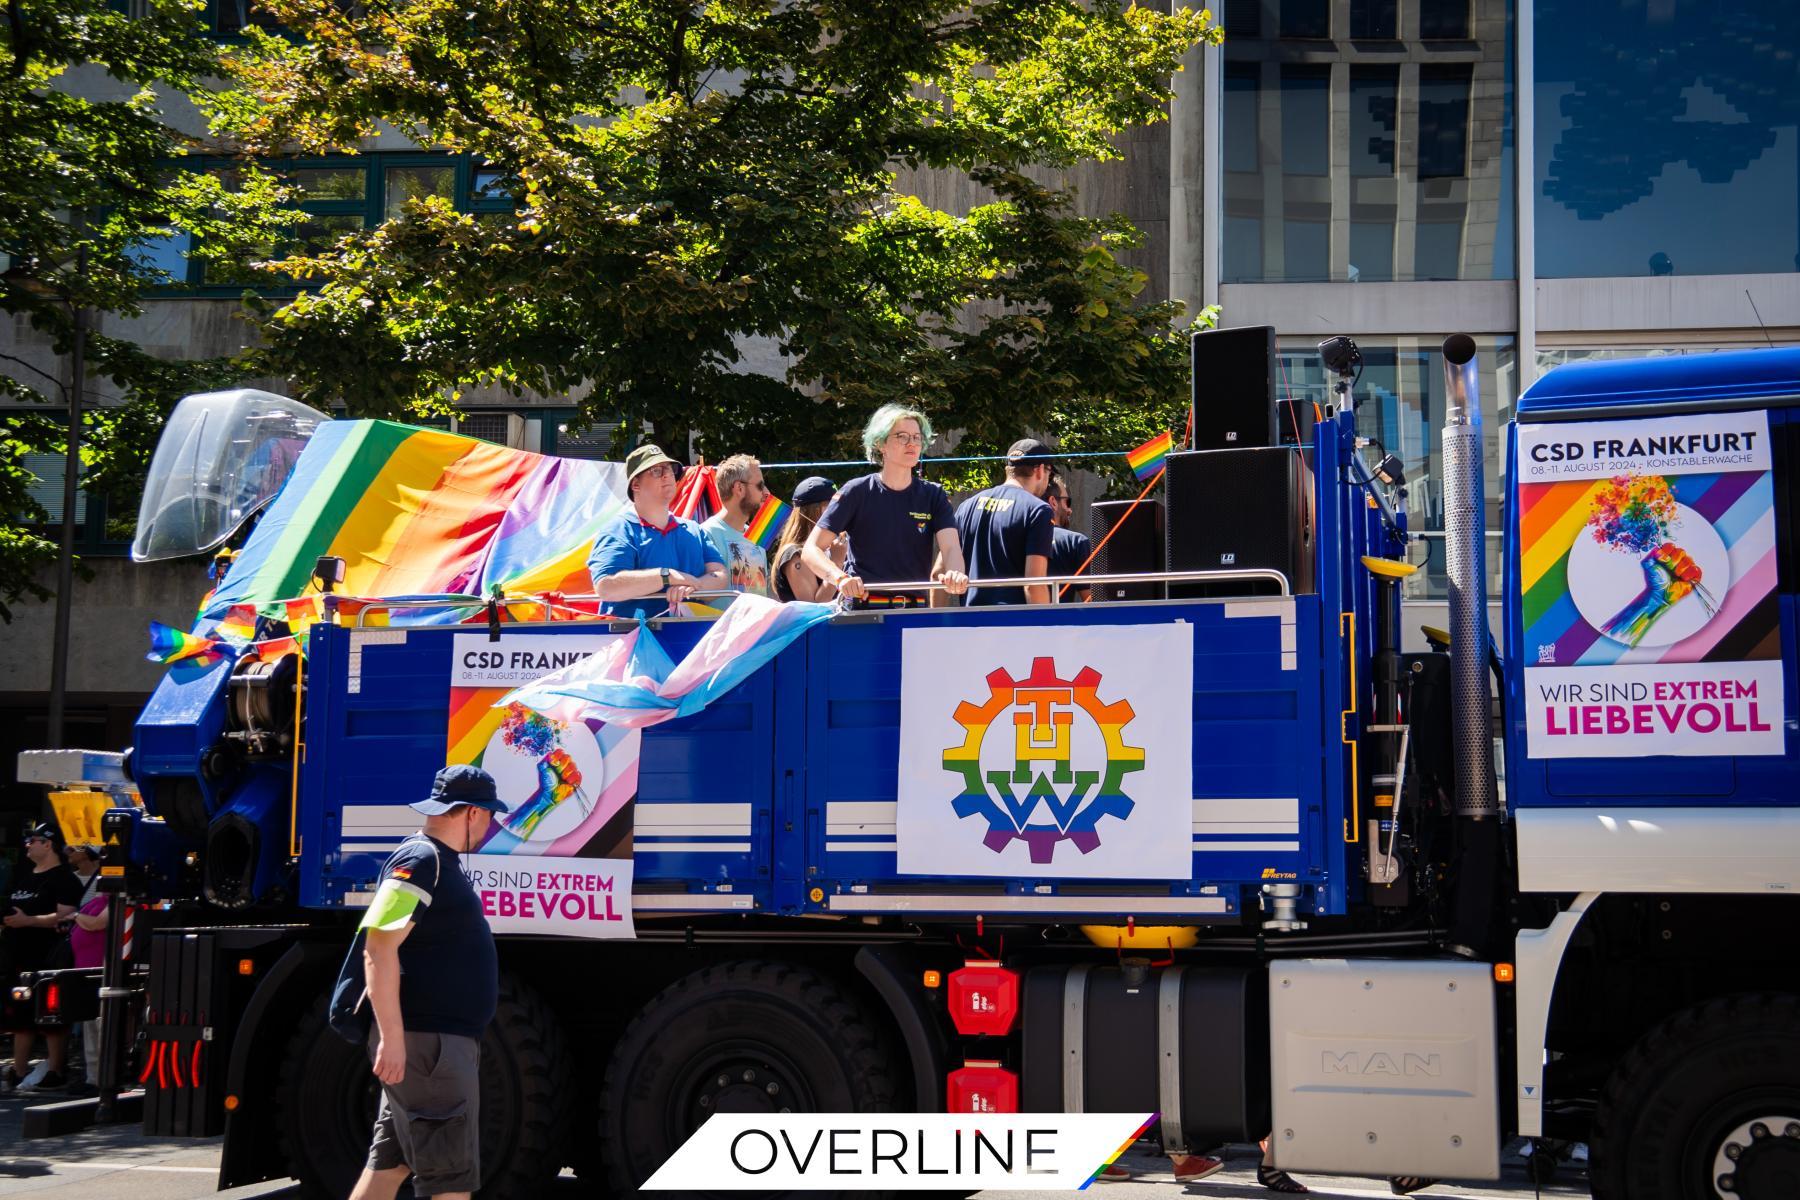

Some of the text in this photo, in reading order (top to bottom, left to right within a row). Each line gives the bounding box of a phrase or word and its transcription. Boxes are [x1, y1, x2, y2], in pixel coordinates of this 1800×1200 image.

[1531, 432, 1757, 463] CSD FRANKFURT
[1563, 462, 1605, 473] AUGUST
[1608, 460, 1636, 471] 2024
[1646, 453, 1753, 469] KONSTABLERWACHE
[976, 496, 1015, 512] THW
[463, 651, 505, 669] CSD
[487, 672, 519, 680] AUGUST
[521, 672, 542, 680] 2024
[1540, 680, 1758, 703] WIR SIND EXTREM
[1545, 702, 1772, 736] LIEBEVOLL
[487, 871, 533, 889] SIND
[536, 873, 614, 892] EXTREM
[481, 890, 623, 921] EBEVOLL
[1321, 1050, 1441, 1077] MAN
